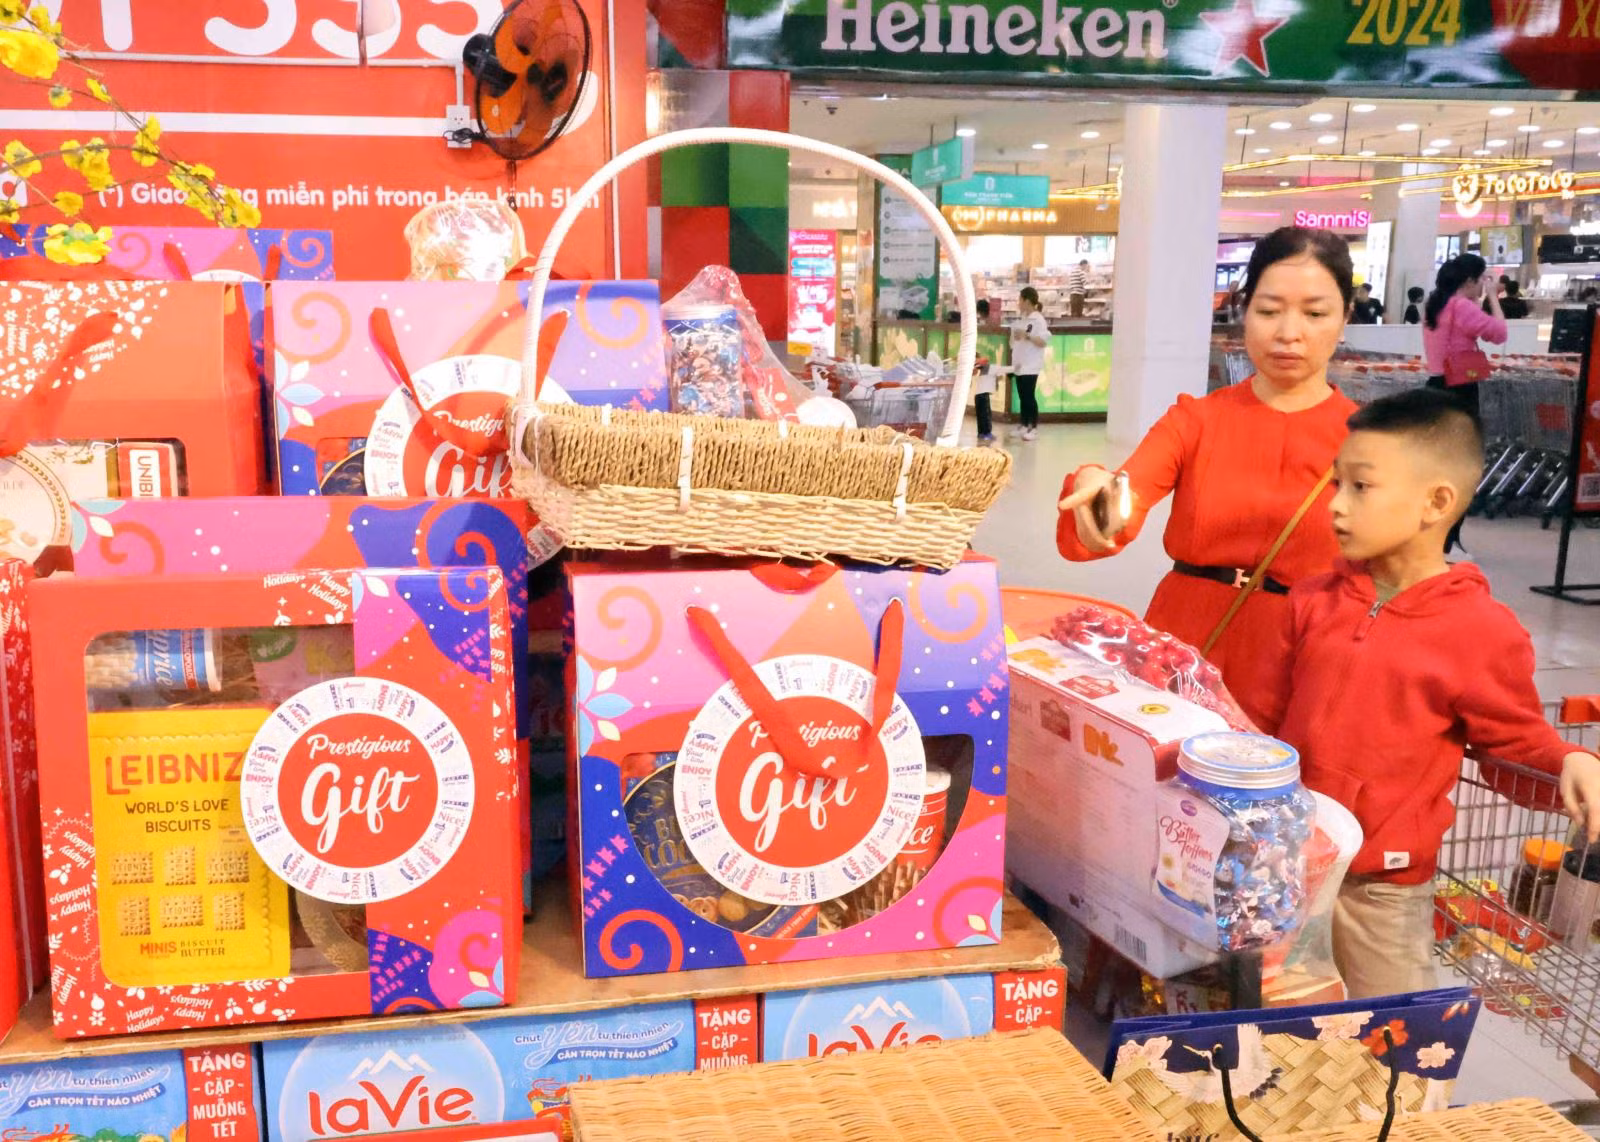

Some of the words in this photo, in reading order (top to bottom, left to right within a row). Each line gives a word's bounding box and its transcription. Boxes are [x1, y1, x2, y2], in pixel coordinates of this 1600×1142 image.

[821, 0, 1168, 59] Heineken
[1346, 0, 1461, 46] 2024
[267, 181, 325, 206] miễn
[333, 184, 368, 212] phí
[307, 584, 349, 611] Holidays
[306, 733, 411, 760] Prestigious
[105, 751, 246, 795] LEIBNIZ
[125, 800, 190, 815] WORLD'S
[193, 799, 229, 812] LOVE
[301, 761, 420, 854] Gift
[145, 819, 211, 833] BISCUITS
[59, 845, 90, 869] Happy
[49, 884, 91, 905] Holidays
[60, 899, 91, 917] Happy
[140, 941, 177, 955] MINIS
[180, 939, 225, 948] BISCUIT
[180, 947, 225, 958] BUTTER
[57, 973, 78, 1006] Happy
[170, 994, 214, 1009] Holidays
[1003, 978, 1058, 1004] TẶNG
[126, 1005, 155, 1023] Happy
[126, 1014, 165, 1034] Holidays
[173, 1007, 206, 1022] Happy
[699, 1006, 752, 1030] TẶNG
[188, 1051, 246, 1076] TẶNG
[205, 1077, 234, 1097] CẶP
[193, 1097, 247, 1121] MUỖNG
[308, 1075, 474, 1136] laVie
[211, 1119, 237, 1138] TẾT
